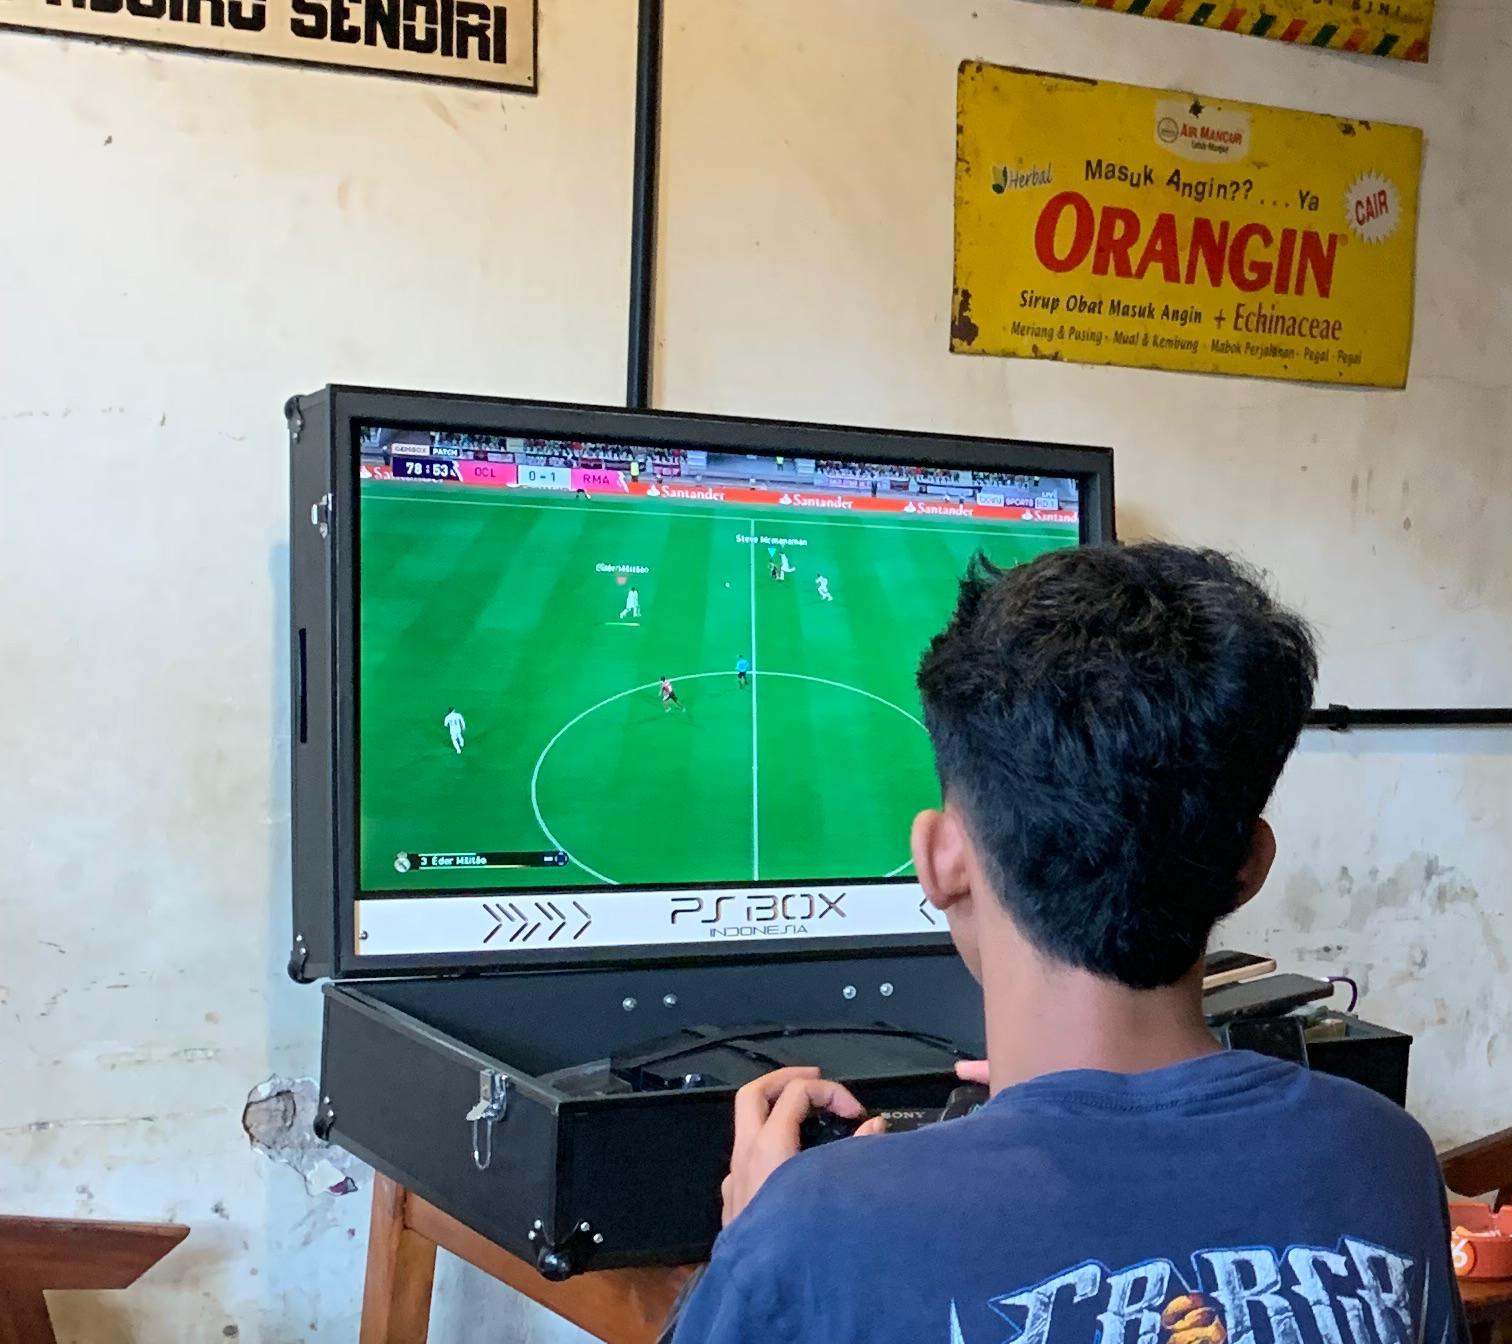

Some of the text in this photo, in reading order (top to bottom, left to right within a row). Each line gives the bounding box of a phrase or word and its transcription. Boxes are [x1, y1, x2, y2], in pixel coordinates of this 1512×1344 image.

[1181, 122, 1198, 138] AIR
[1008, 162, 1053, 189] Herbal
[1085, 159, 1153, 188] Masuk
[1298, 189, 1321, 211] Ya
[1355, 189, 1390, 227] CAIR
[1033, 191, 1338, 299] ORANGIN
[1019, 290, 1061, 315] Sirup
[1066, 294, 1104, 316] Obat
[1108, 299, 1156, 320] Masuk
[1160, 304, 1203, 327] Angin
[1233, 302, 1343, 341] Echinaceae
[1010, 320, 1055, 342] Meriang
[1068, 326, 1103, 347] Pusing
[1113, 330, 1140, 347] Mual
[583, 474, 609, 485] RMA
[661, 486, 725, 502] Santander
[792, 494, 853, 510] Santander
[917, 502, 974, 518] Santander
[671, 892, 847, 924] PS BOX
[709, 925, 808, 937] INDONESIA
[881, 1111, 926, 1120] SONY
